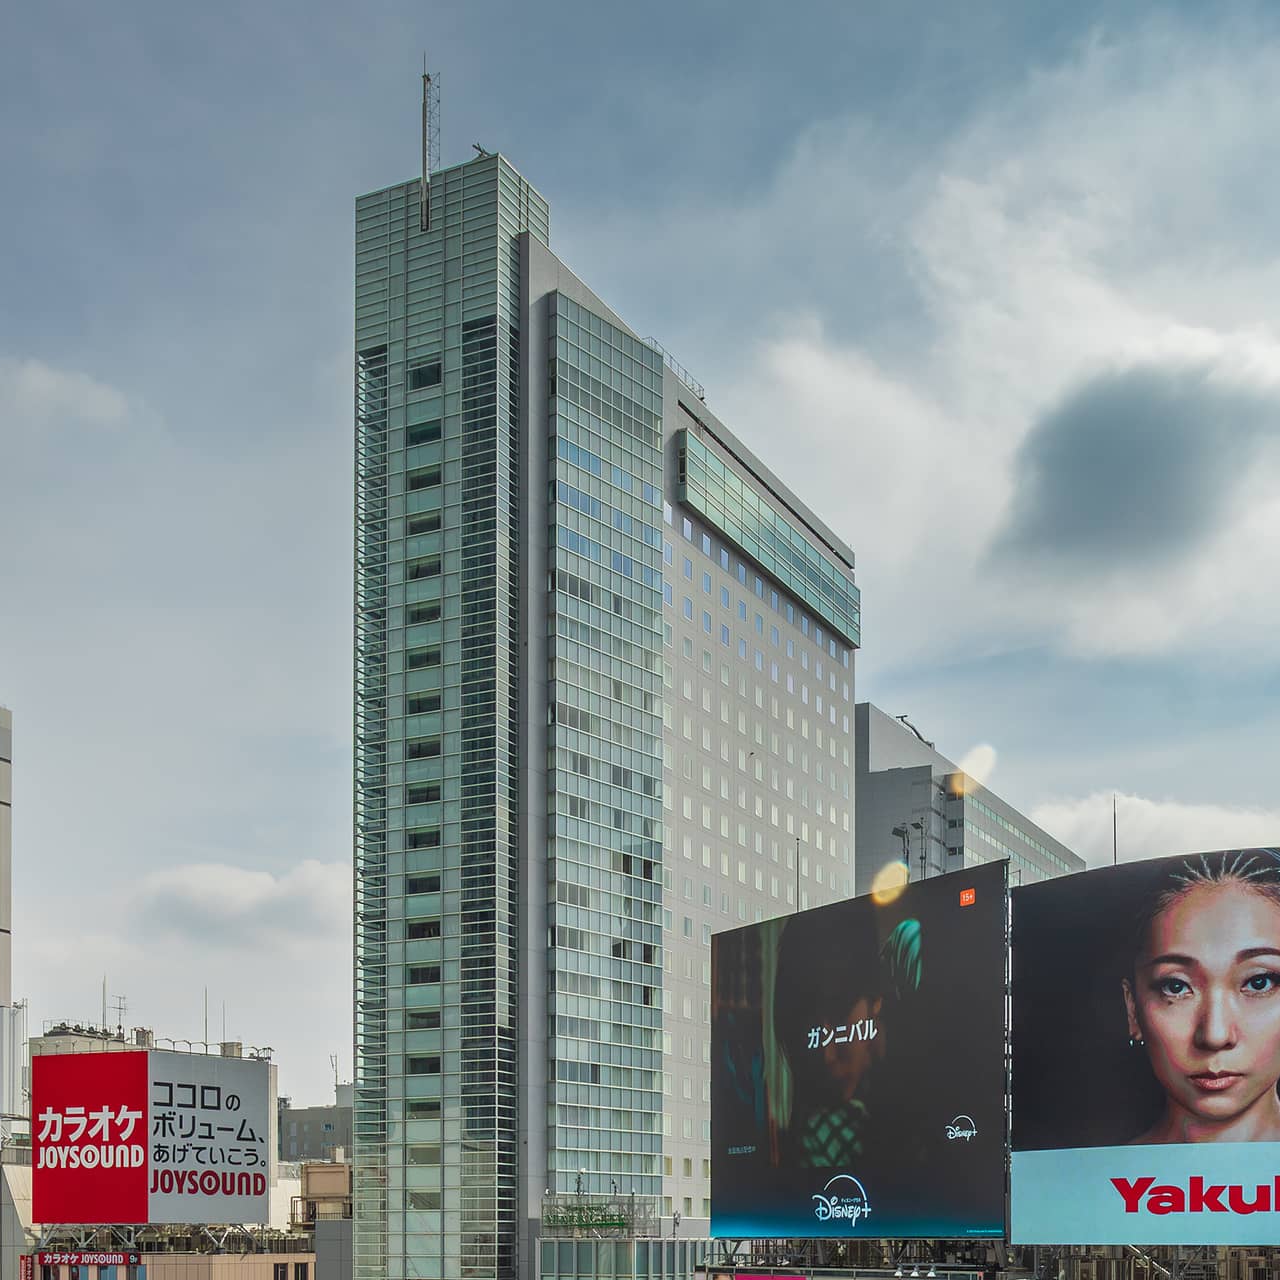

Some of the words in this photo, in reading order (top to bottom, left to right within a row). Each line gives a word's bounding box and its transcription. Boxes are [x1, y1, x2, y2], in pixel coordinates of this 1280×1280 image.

[807, 1019, 878, 1049] ガンニバル
[152, 1081, 241, 1111] ココロの
[38, 1104, 143, 1143] カラオケ
[152, 1111, 266, 1144] ボリューム、
[37, 1144, 144, 1170] JOYSOUND
[152, 1142, 267, 1167] あげていこう。
[150, 1169, 267, 1197] JOYSOUND
[812, 1190, 872, 1227] Disney+
[44, 1253, 79, 1264] カラオケ
[80, 1254, 124, 1264] JOYSOUND
